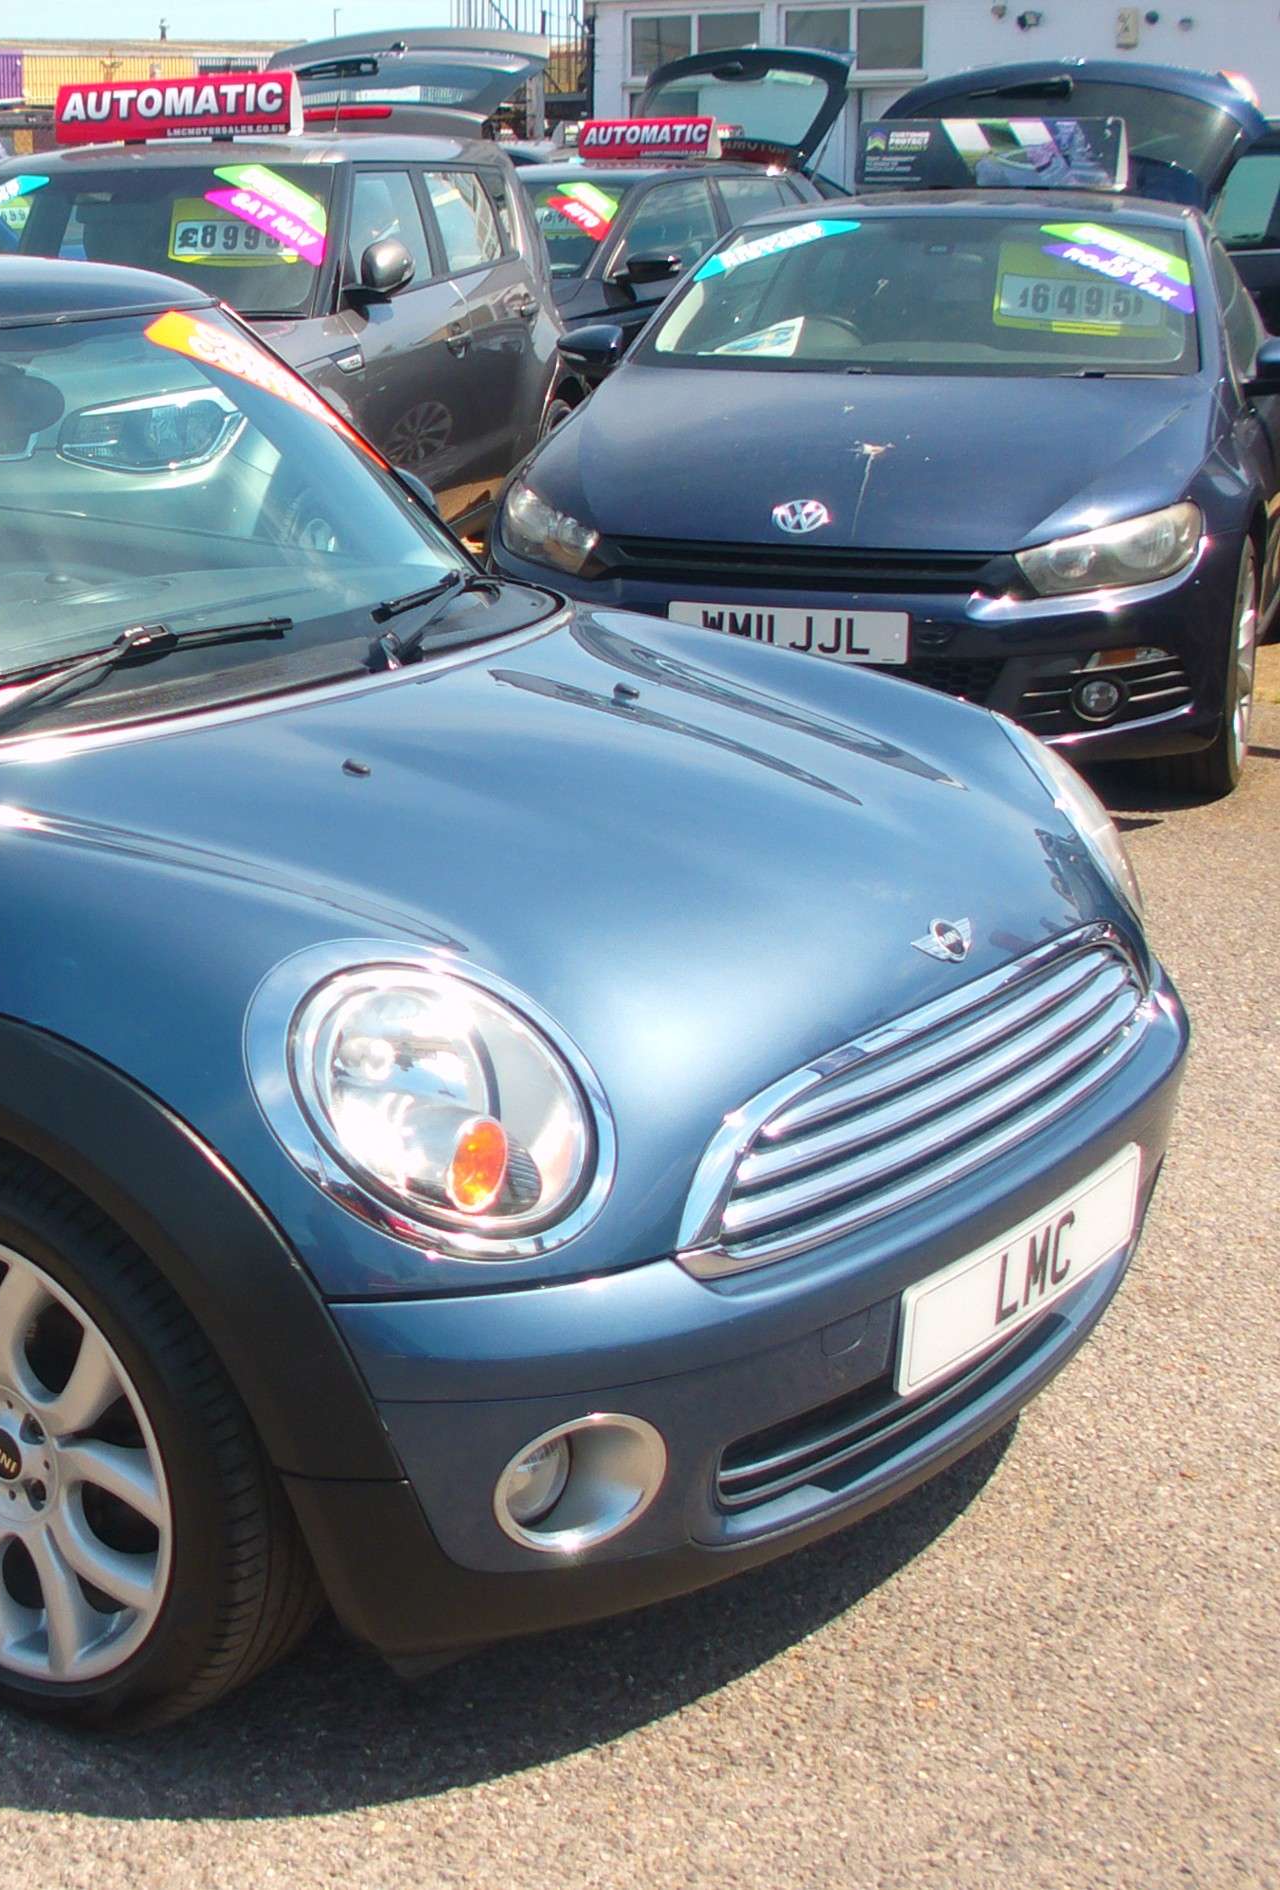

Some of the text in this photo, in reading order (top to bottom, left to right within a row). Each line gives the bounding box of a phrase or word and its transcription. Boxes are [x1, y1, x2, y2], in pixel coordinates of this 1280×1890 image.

[61, 82, 283, 122] AUTOMATIC
[583, 123, 709, 146] AUTOMATIC
[230, 192, 277, 219] SAT
[271, 216, 319, 246] NAV
[789, 616, 870, 655] JJL
[994, 1210, 1076, 1326] LMC
